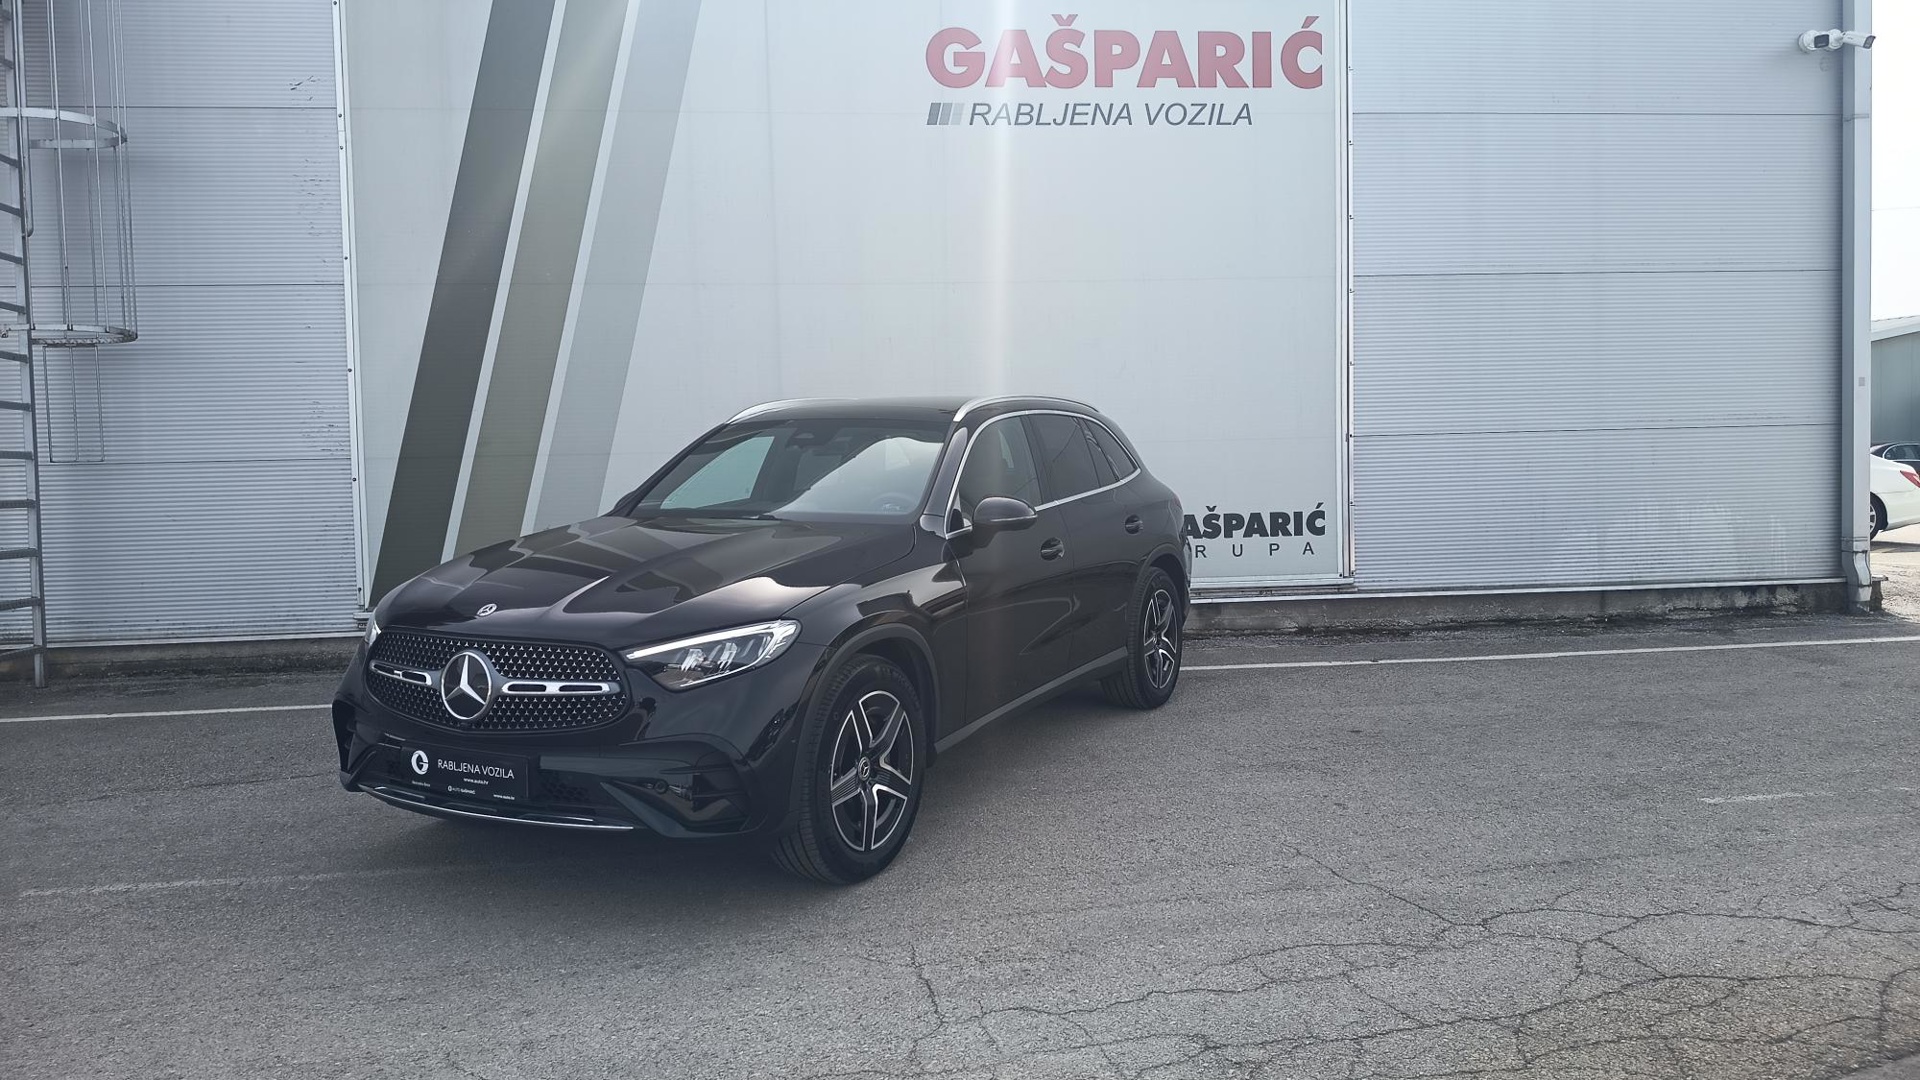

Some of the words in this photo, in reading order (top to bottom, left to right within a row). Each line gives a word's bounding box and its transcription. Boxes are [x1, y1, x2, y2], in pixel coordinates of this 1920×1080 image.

[925, 14, 1324, 89] GAŠPARIĆ
[968, 102, 1134, 126] RABLJENA
[1145, 102, 1253, 126] VOZILA
[1183, 502, 1326, 539] AŠPARIĆ
[1194, 541, 1315, 558] RUPA
[437, 758, 480, 775] RABLJENA
[481, 765, 515, 779] VOZILA
